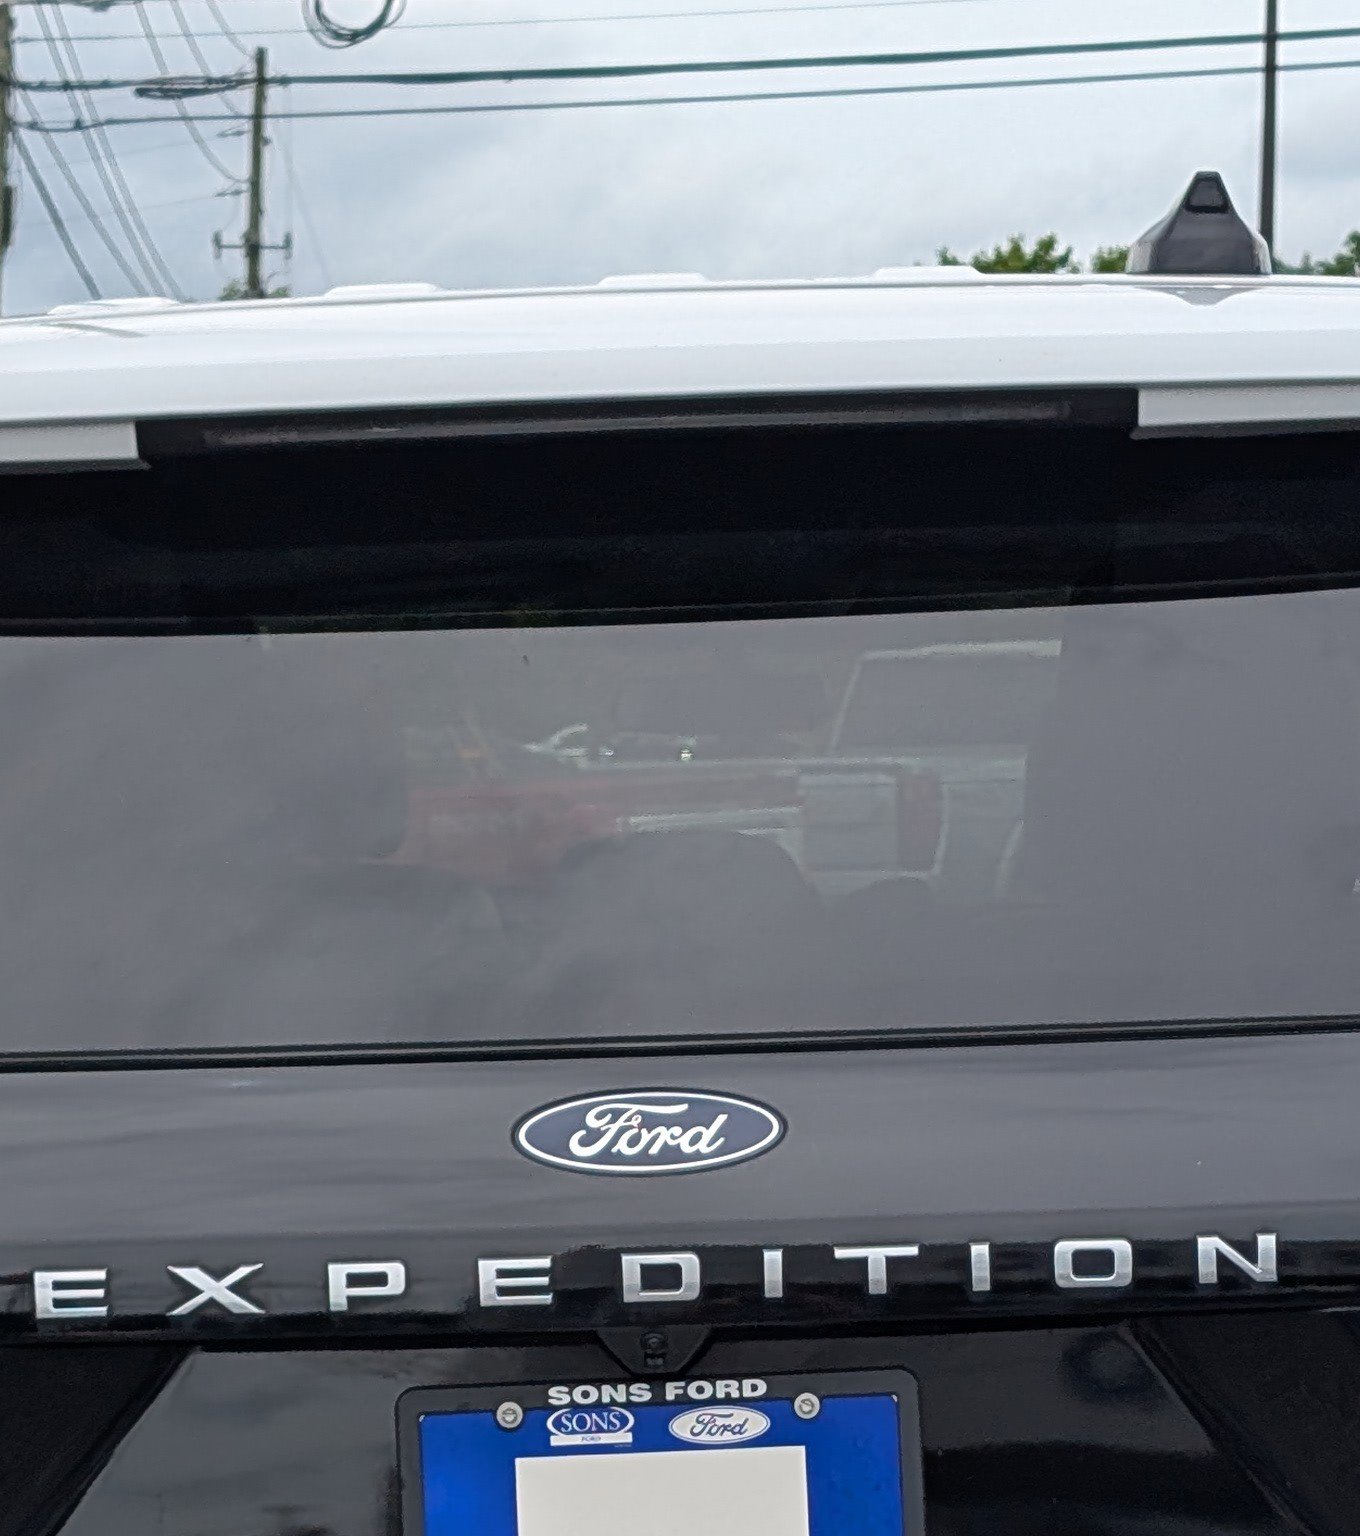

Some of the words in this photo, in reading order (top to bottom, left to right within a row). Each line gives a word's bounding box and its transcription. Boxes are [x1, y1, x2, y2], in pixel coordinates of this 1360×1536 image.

[566, 1102, 726, 1160] Ford
[33, 1231, 1281, 1321] EXPEDITION
[547, 1382, 653, 1406] SONS
[665, 1378, 768, 1401] FORD
[560, 1411, 622, 1433] SONS
[690, 1412, 749, 1437] Ford
